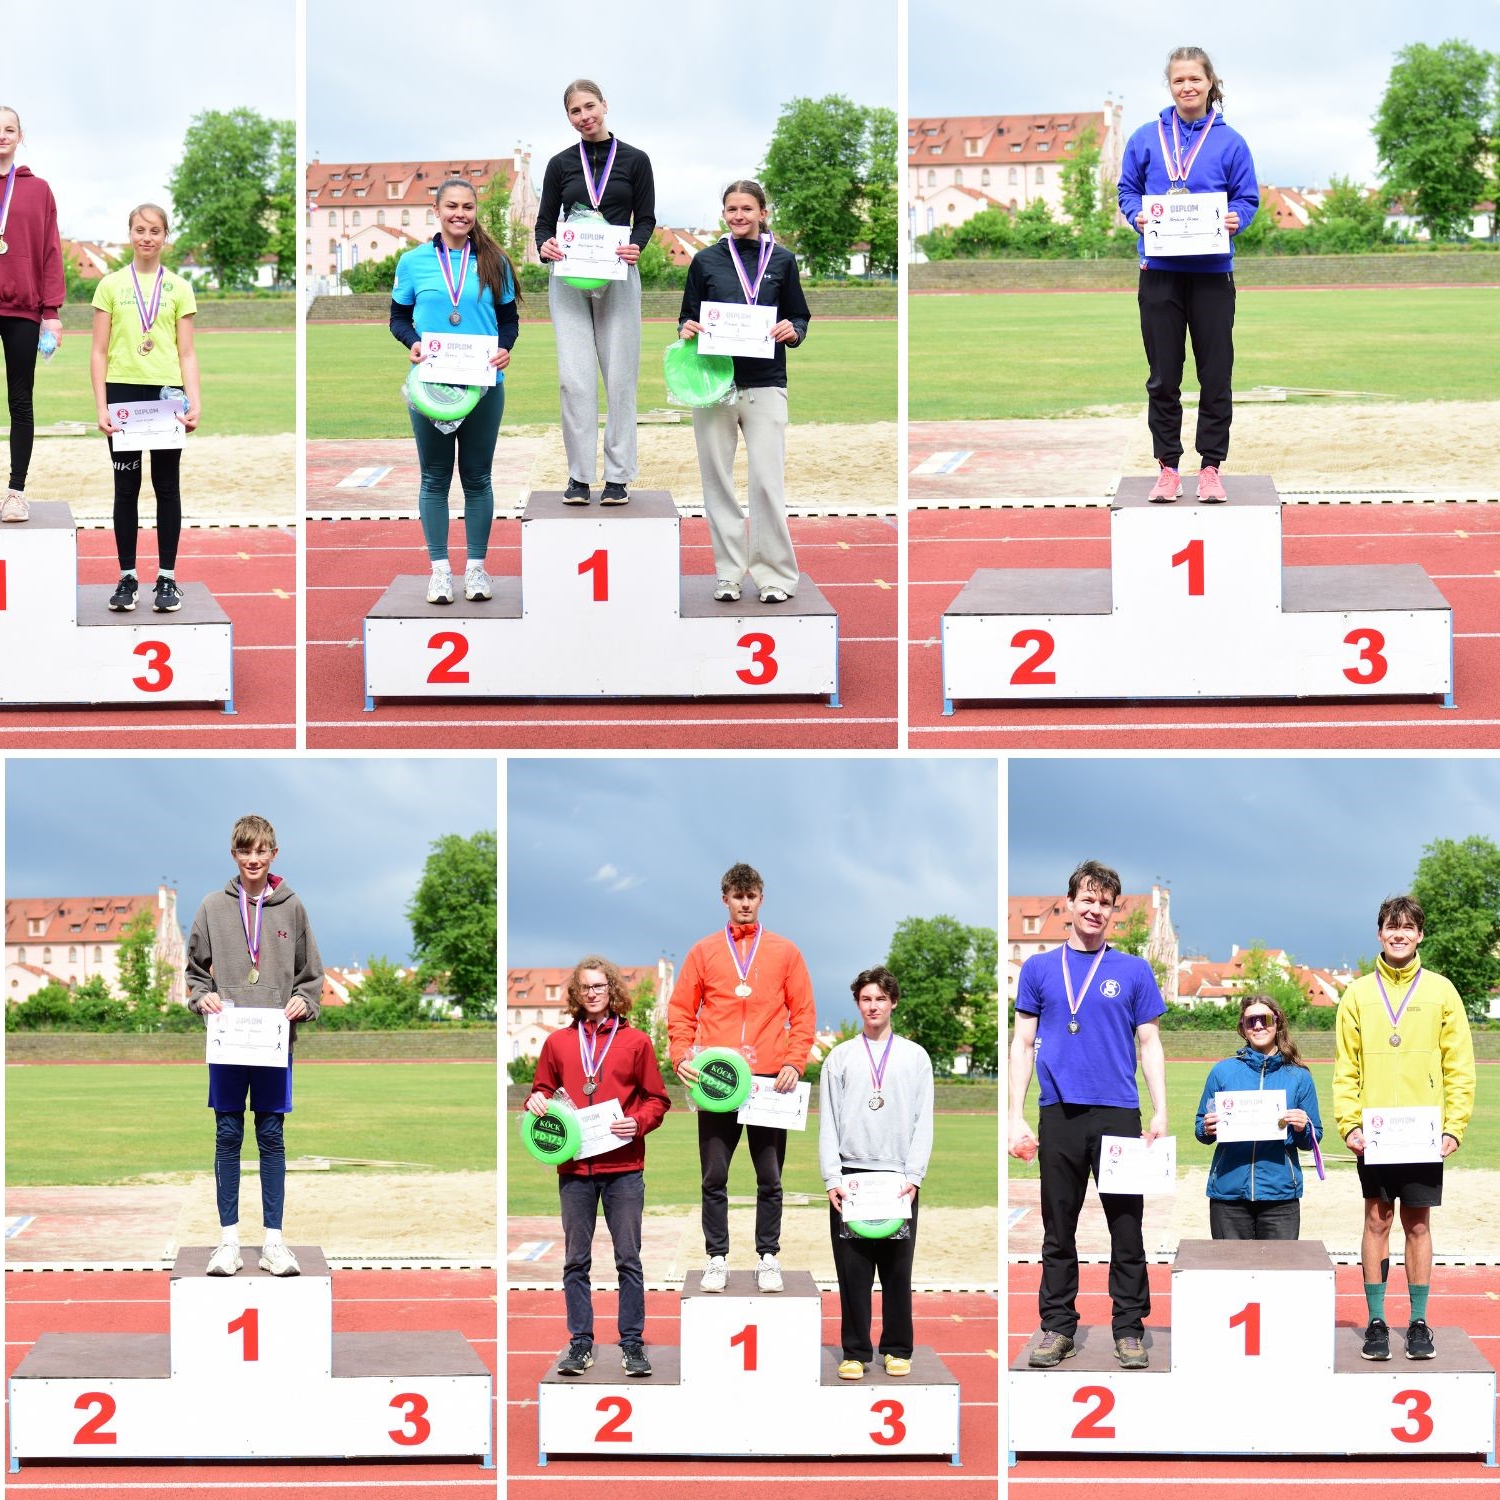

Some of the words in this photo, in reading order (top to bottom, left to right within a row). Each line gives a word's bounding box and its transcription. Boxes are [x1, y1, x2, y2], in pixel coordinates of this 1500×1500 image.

[1170, 204, 1199, 213] DIPLOM
[580, 232, 605, 241] DIPLOM
[446, 342, 473, 351] DIPLOM
[134, 408, 159, 416] DIPLOM
[578, 550, 608, 601] 1
[1172, 540, 1204, 596] 1
[133, 641, 173, 692] 3
[427, 632, 469, 683] 2
[737, 633, 778, 685] 3
[1010, 629, 1056, 685] 2
[1343, 628, 1388, 684] 3
[701, 1075, 733, 1094] FD-175
[710, 1064, 734, 1081] KÖCK
[535, 1130, 562, 1146] FD-175
[539, 1119, 561, 1132] KÖCK
[228, 1308, 258, 1361] 1
[730, 1324, 758, 1372] 1
[1230, 1303, 1260, 1356] 1
[74, 1392, 116, 1444] 2
[389, 1393, 430, 1446] 3
[596, 1396, 632, 1442] 2
[870, 1400, 906, 1446] 3
[1072, 1386, 1115, 1438] 2
[1392, 1390, 1433, 1443] 3
